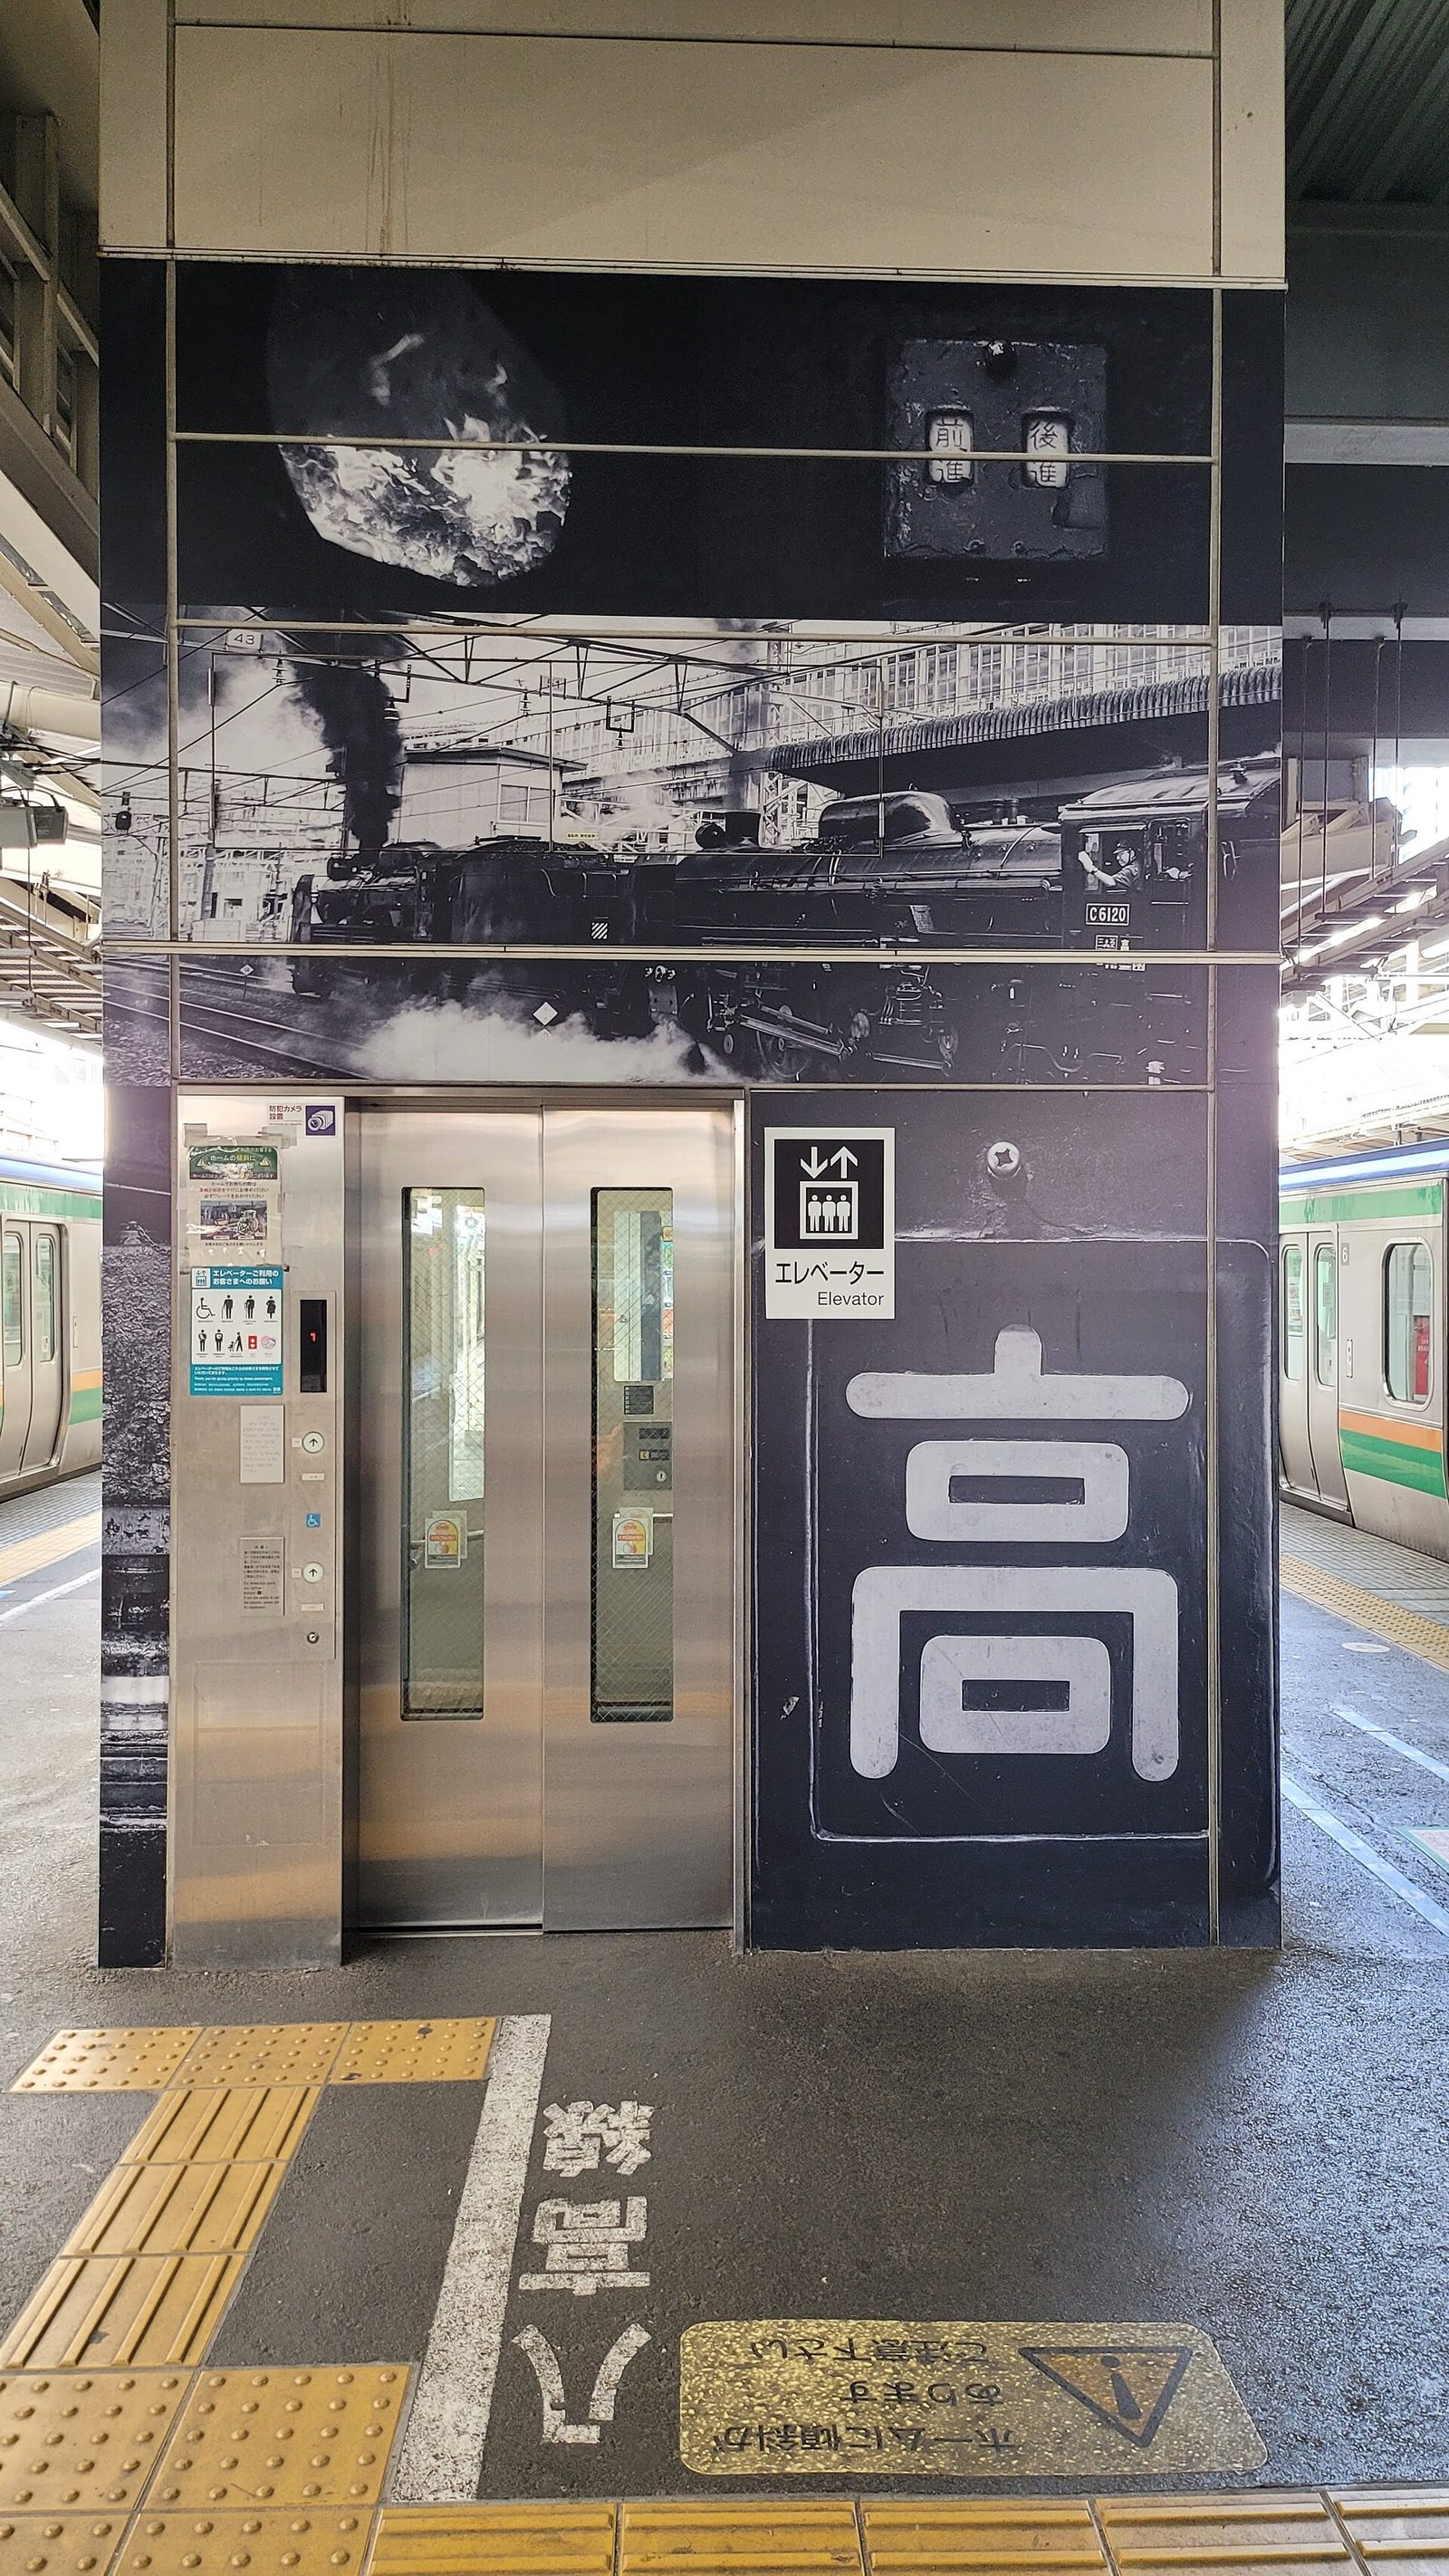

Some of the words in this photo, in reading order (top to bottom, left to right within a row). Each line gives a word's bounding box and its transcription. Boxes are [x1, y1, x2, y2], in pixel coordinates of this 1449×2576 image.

[1030, 420, 1058, 484] 後進
[235, 633, 255, 645] 43
[1089, 907, 1127, 922] C6120
[1342, 1246, 1348, 1263] 6
[775, 1261, 885, 1285] エレベーター
[818, 1292, 885, 1306] Elevator
[846, 1324, 1190, 1782] 高
[512, 2100, 654, 2445] 八高線
[749, 2338, 990, 2363] ご注意下さい
[842, 2380, 1005, 2406] あります
[712, 2424, 1015, 2452] ホームに傾斜が
